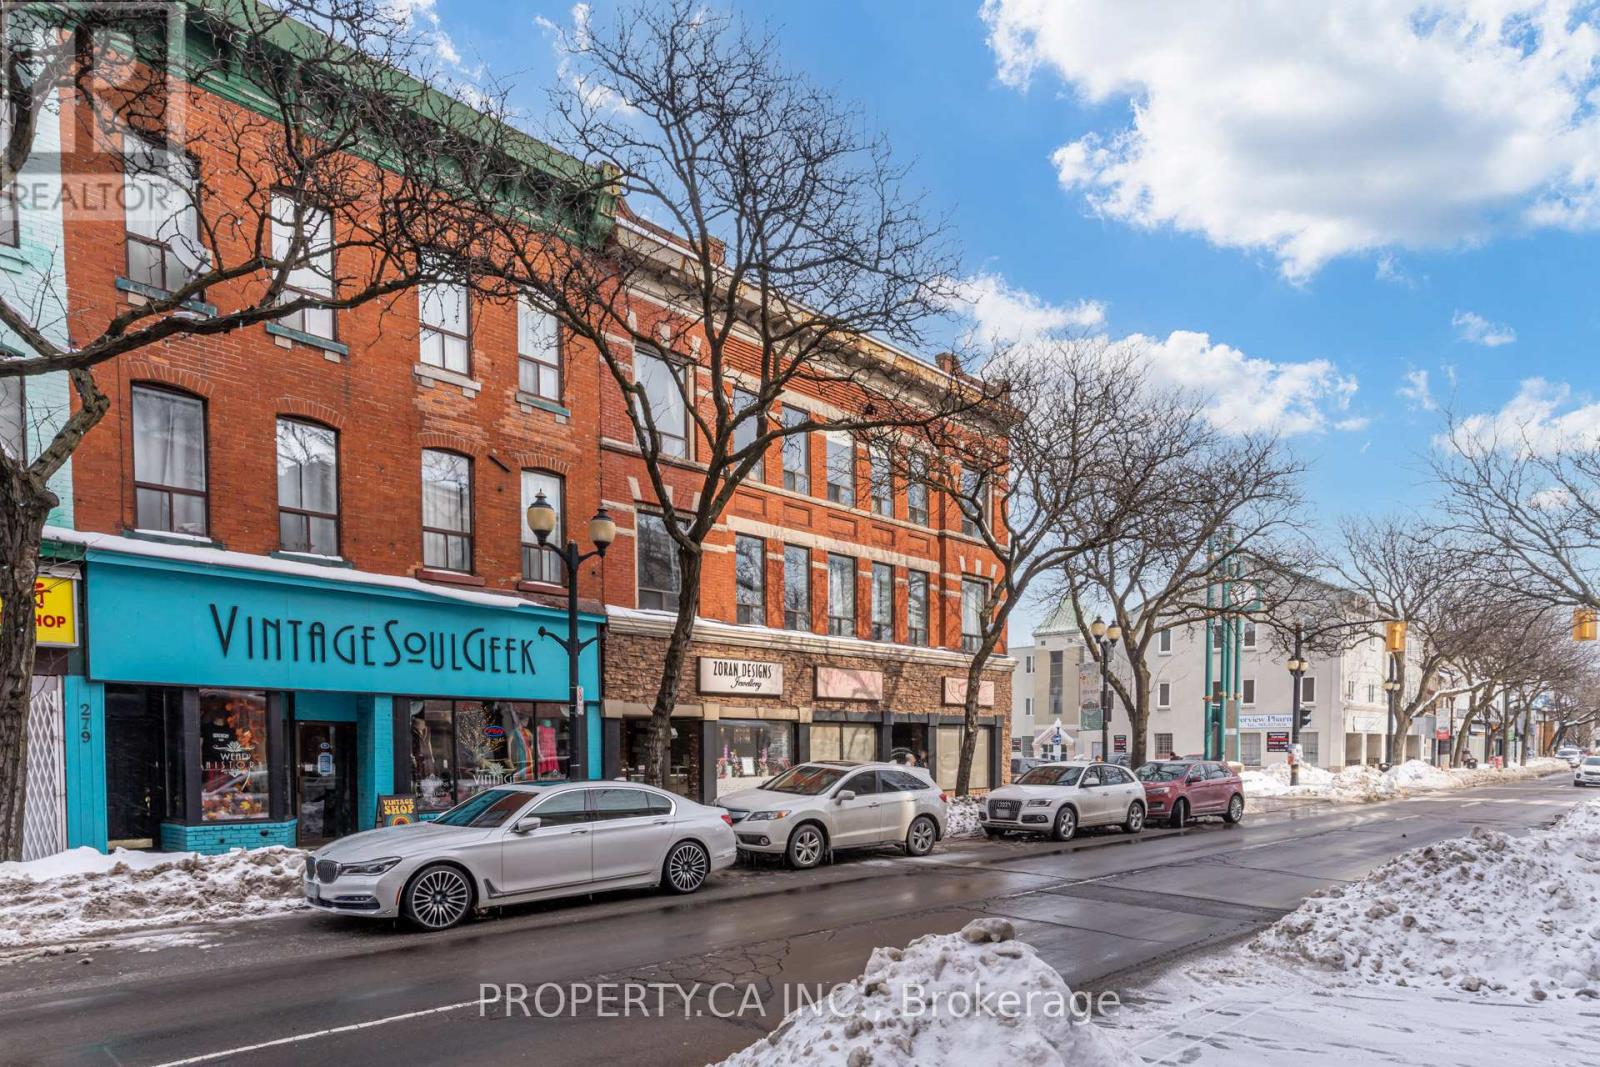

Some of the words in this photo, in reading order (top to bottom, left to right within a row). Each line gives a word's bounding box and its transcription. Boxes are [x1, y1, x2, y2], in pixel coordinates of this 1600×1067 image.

[34, 614, 66, 628] HOP
[713, 661, 739, 676] ZORAN
[742, 663, 772, 679] DESIGNS
[730, 676, 762, 691] Jewellery
[80, 703, 91, 744] 279
[384, 804, 415, 816] SHOP
